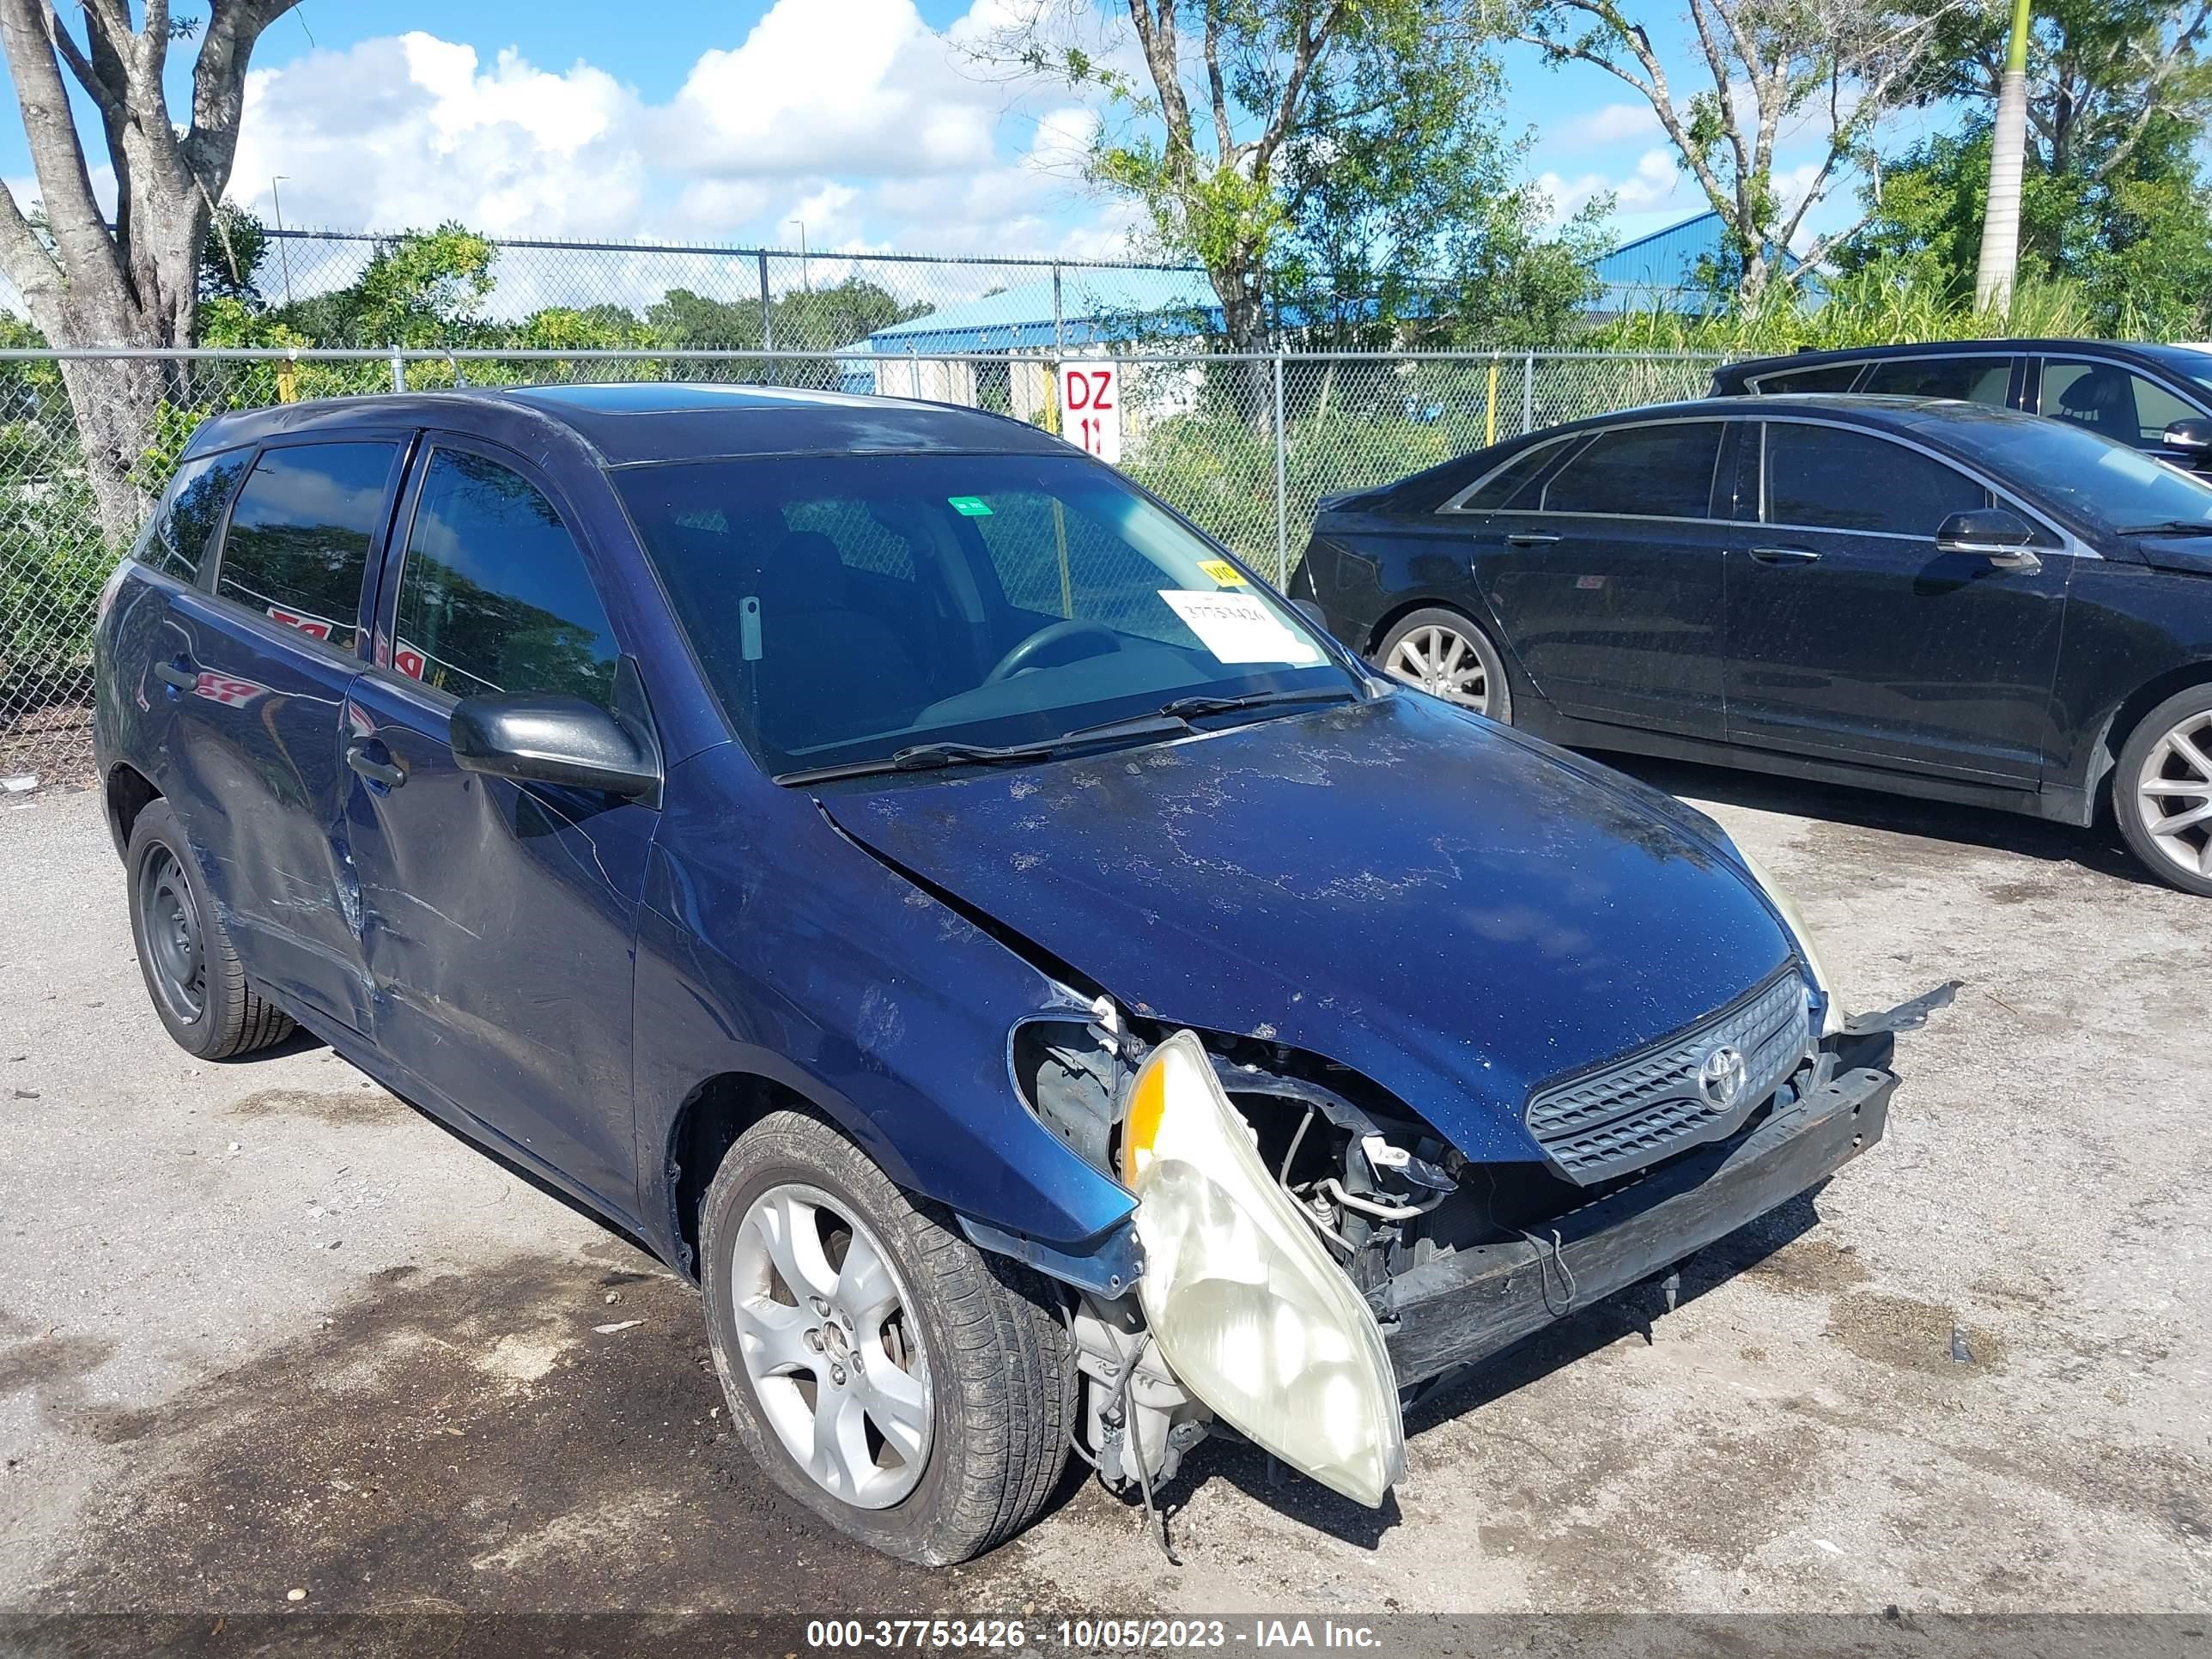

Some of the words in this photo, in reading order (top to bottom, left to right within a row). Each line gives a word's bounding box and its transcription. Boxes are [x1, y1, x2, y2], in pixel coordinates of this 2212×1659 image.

[1066, 370, 1114, 411] DZ
[1079, 417, 1102, 455] 11
[1205, 567, 1239, 581] VIC
